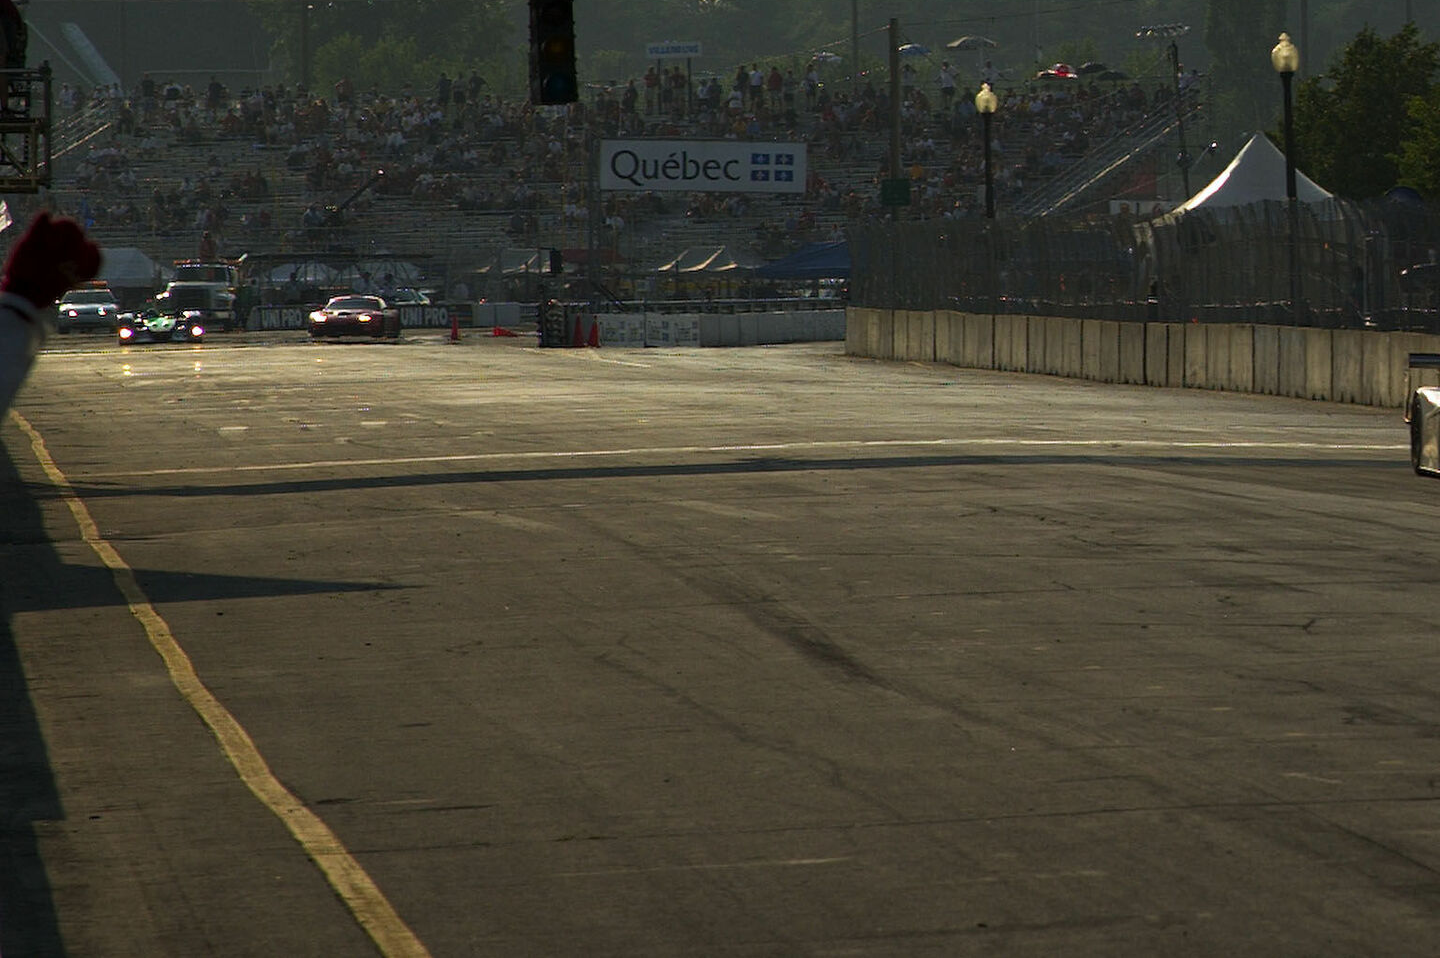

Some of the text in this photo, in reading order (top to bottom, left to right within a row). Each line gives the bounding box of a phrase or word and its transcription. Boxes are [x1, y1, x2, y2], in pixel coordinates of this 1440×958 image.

[611, 149, 741, 186] Québec
[402, 308, 448, 325] UNI PRO
